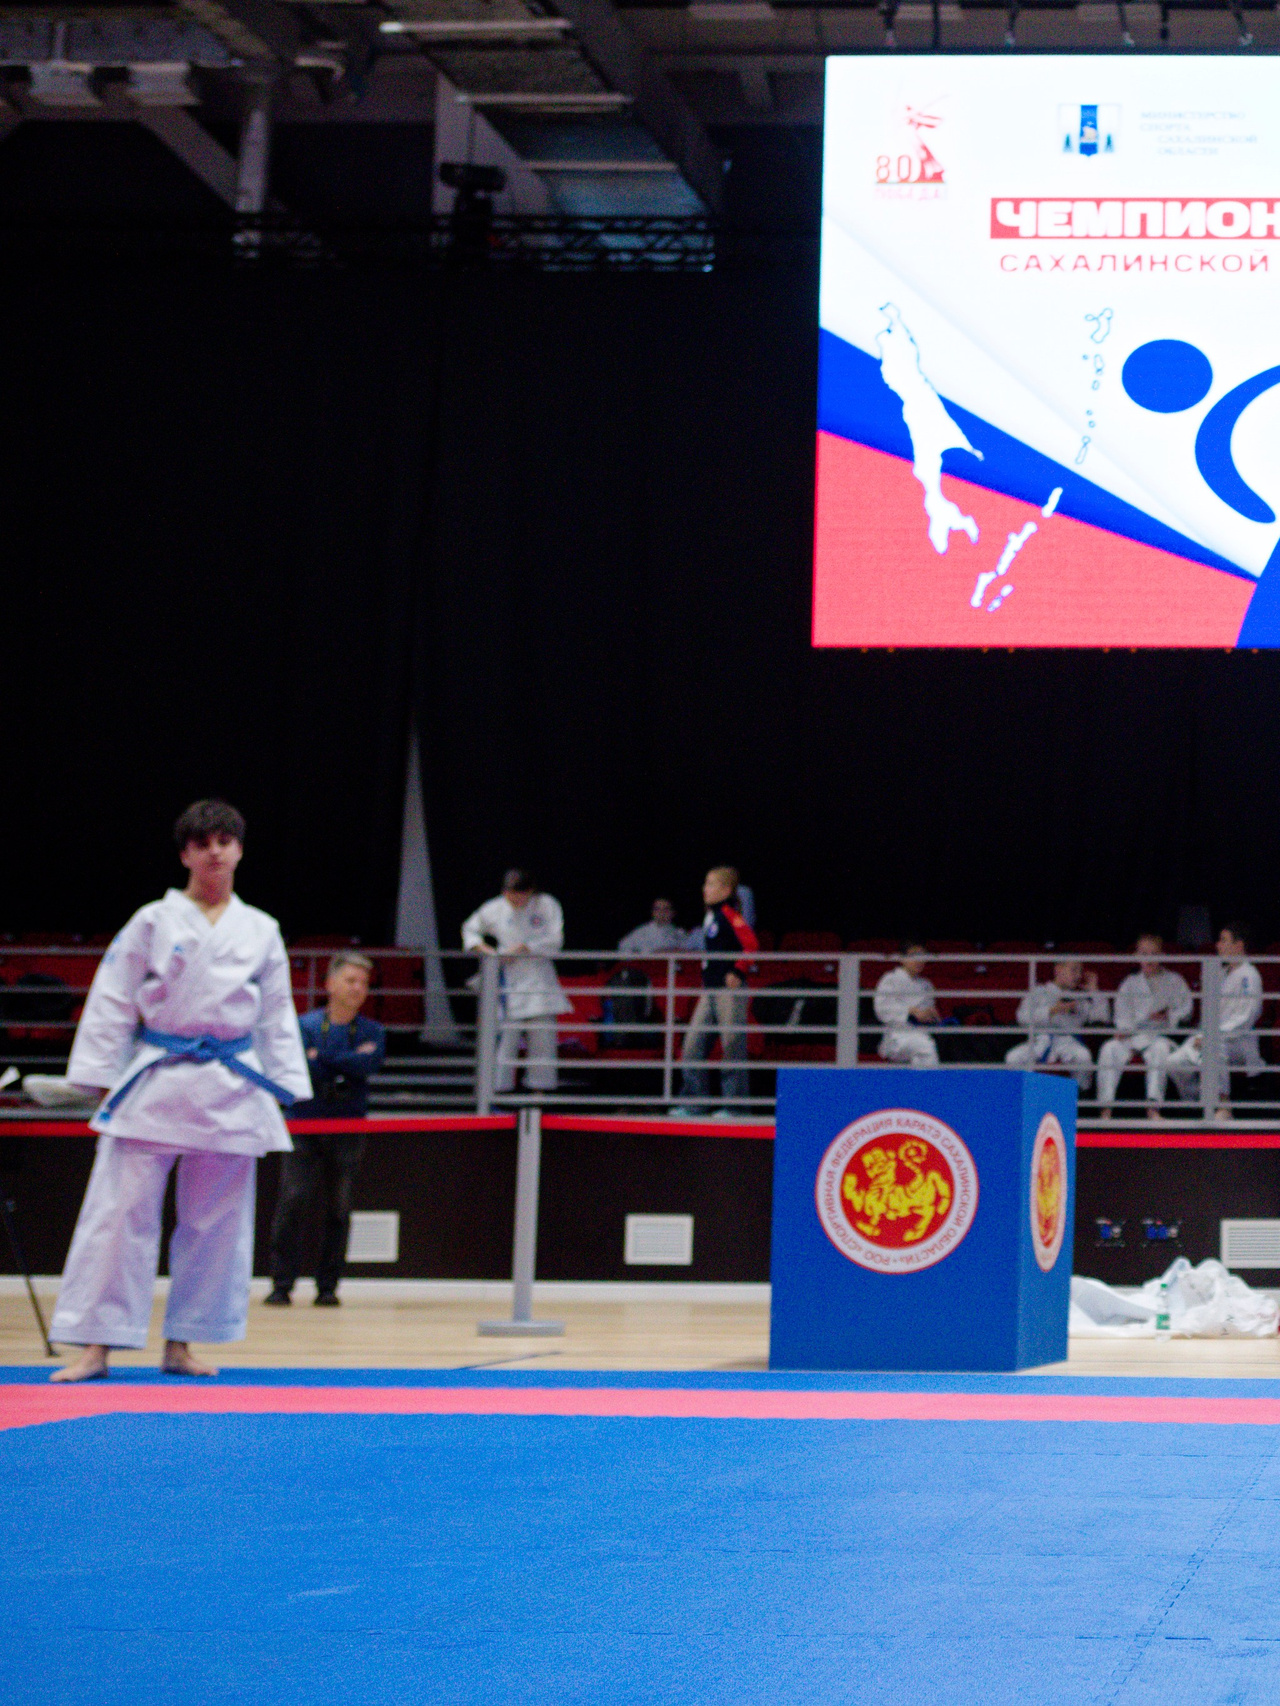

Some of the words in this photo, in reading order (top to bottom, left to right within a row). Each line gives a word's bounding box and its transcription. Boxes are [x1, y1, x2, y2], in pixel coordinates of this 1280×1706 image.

[876, 154, 912, 184] 80
[1000, 249, 1267, 273] САХАЛИНСКОЙ
[831, 1118, 893, 1167] ФЕДЕРАЦИЯ
[896, 1118, 941, 1140] КАРАТЭ
[940, 1137, 972, 1227] САХАЛИНСКОЙ
